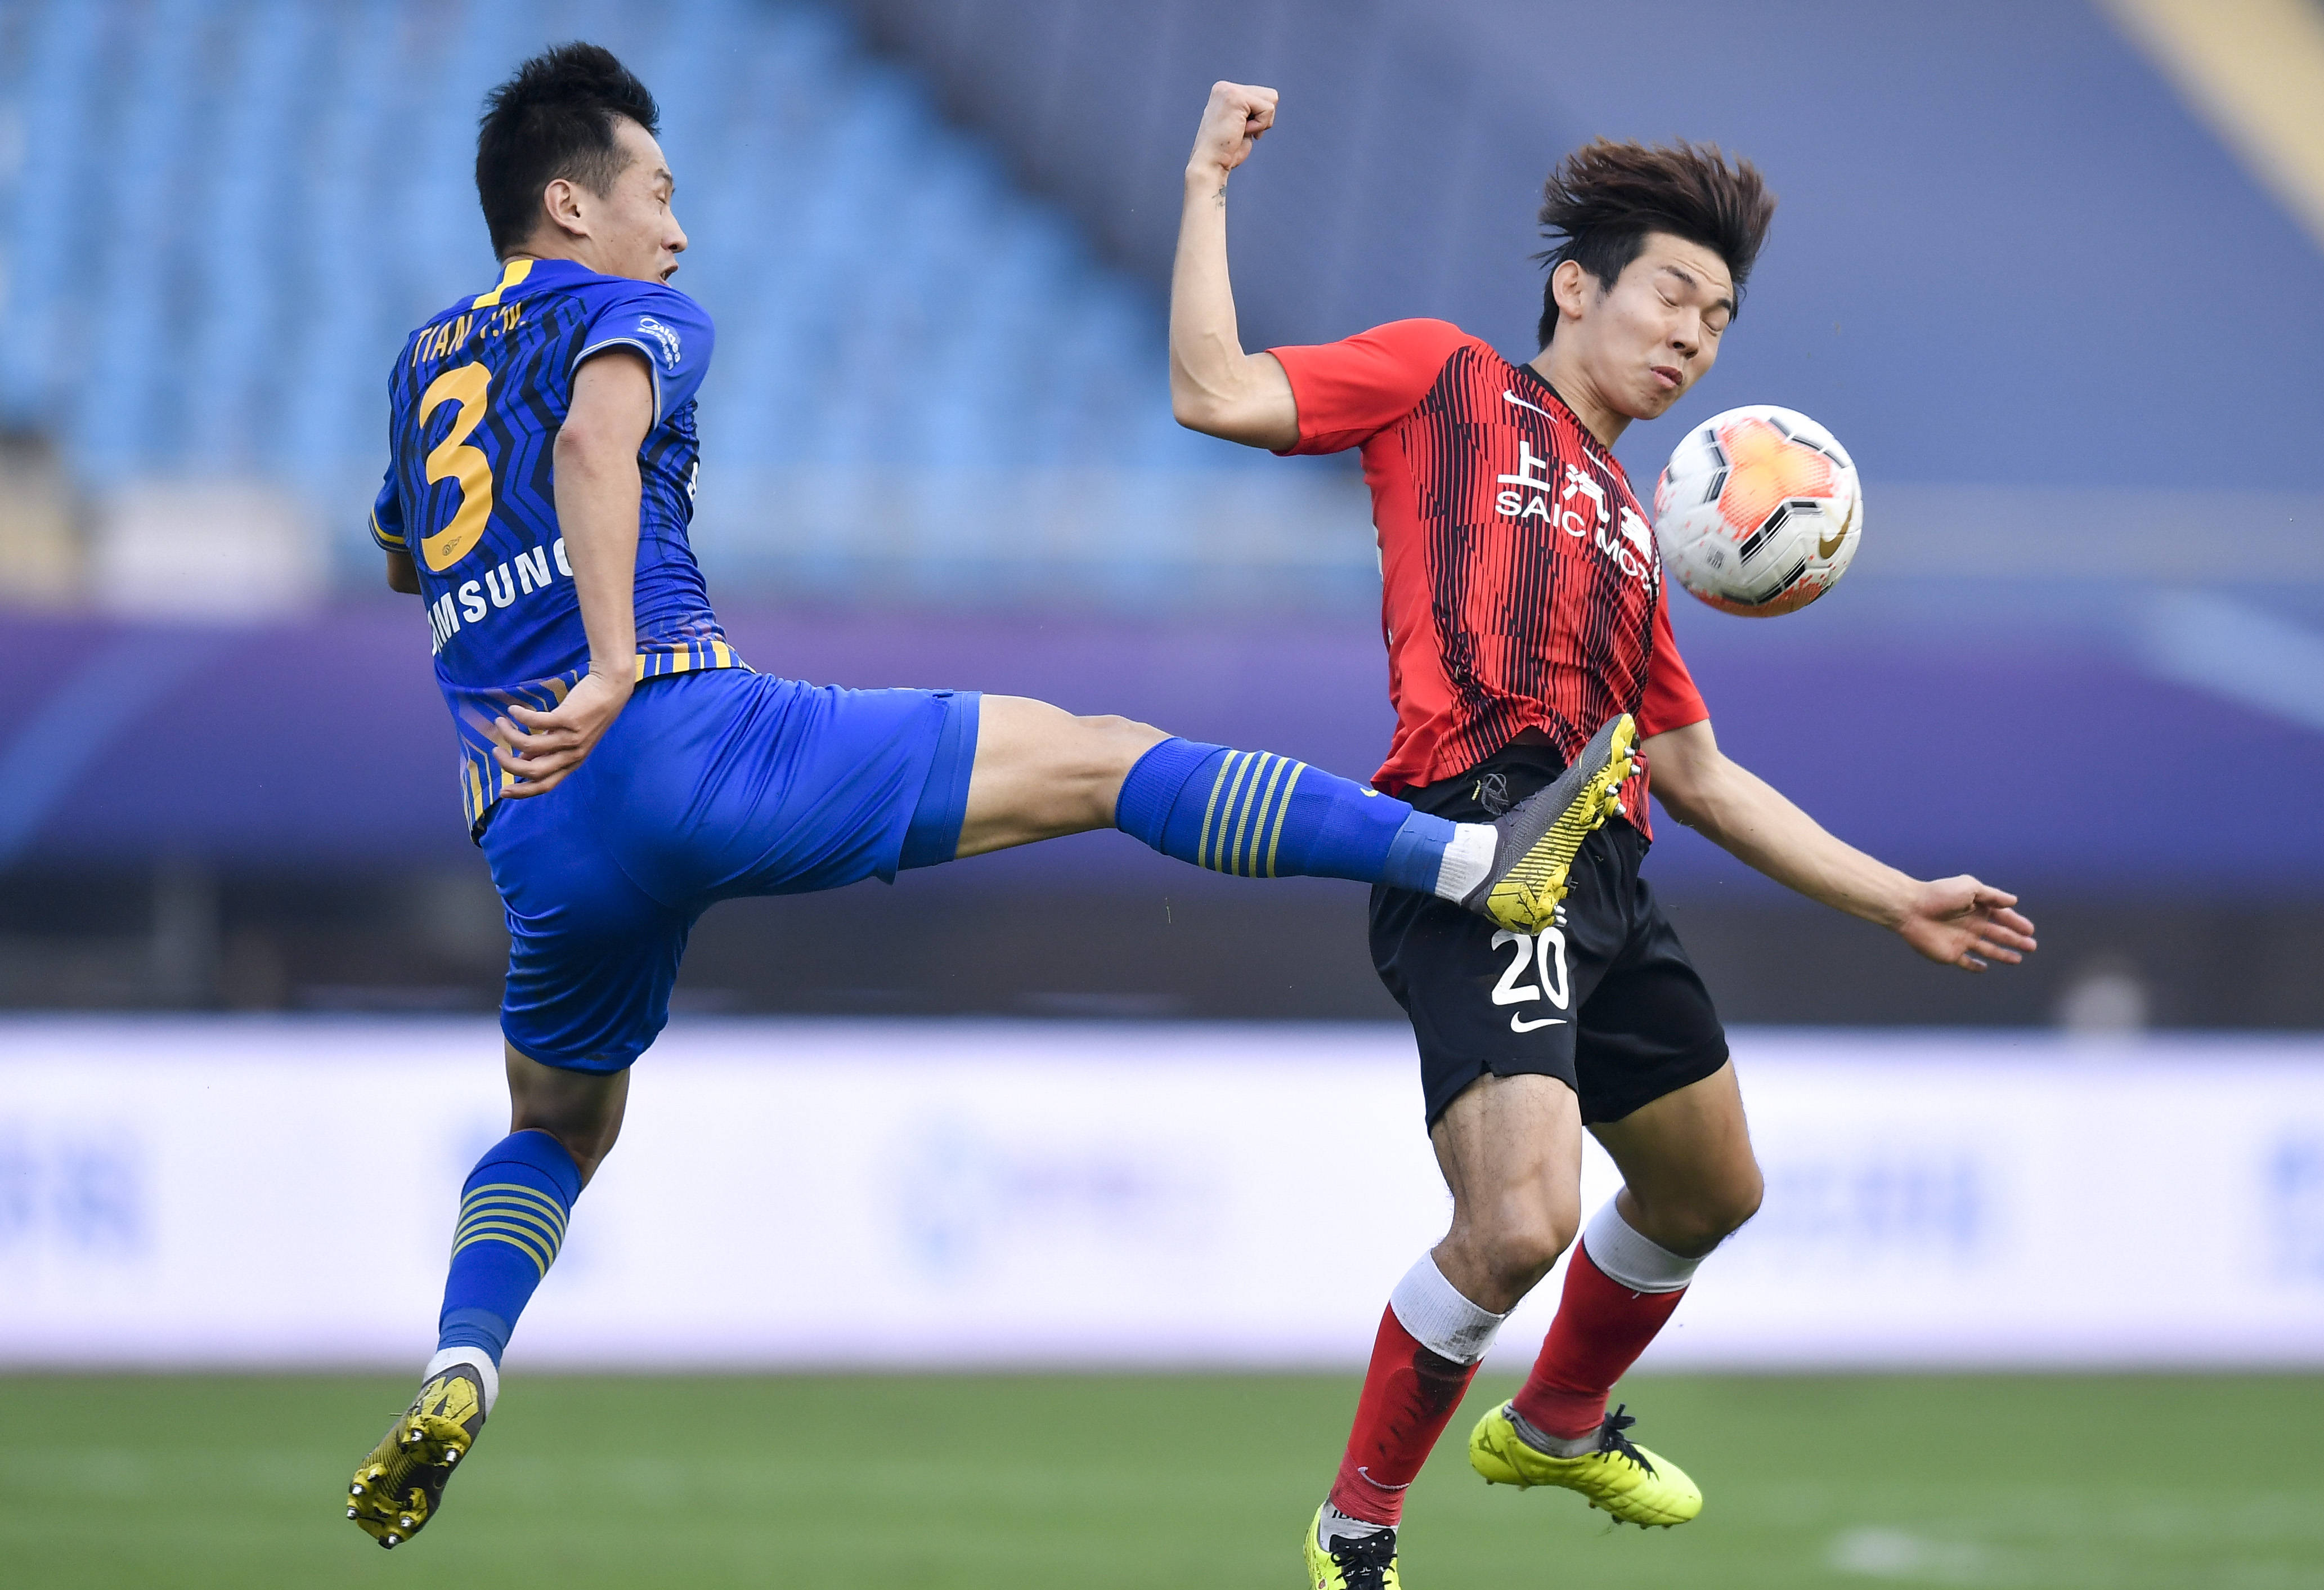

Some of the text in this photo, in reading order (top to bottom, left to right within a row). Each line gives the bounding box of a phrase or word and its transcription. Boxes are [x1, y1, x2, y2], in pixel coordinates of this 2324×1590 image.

[411, 314, 473, 368] TIAN
[419, 361, 493, 572] 3
[1495, 491, 1587, 538] SAIC
[1491, 926, 1569, 1010] 20
